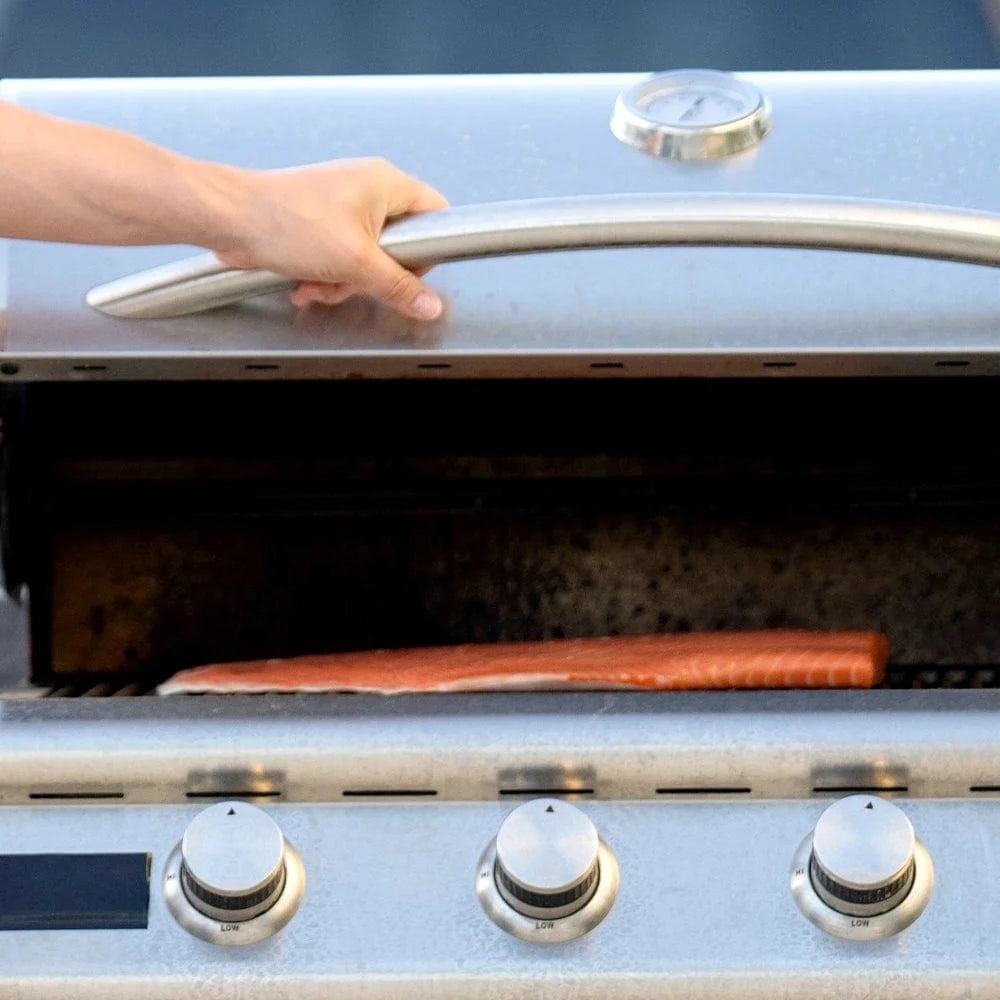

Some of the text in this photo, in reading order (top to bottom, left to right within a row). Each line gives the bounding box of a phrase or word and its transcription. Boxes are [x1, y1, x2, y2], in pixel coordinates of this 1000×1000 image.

[535, 921, 554, 930] LOW
[851, 919, 870, 927] LOW
[220, 924, 240, 932] LOW
